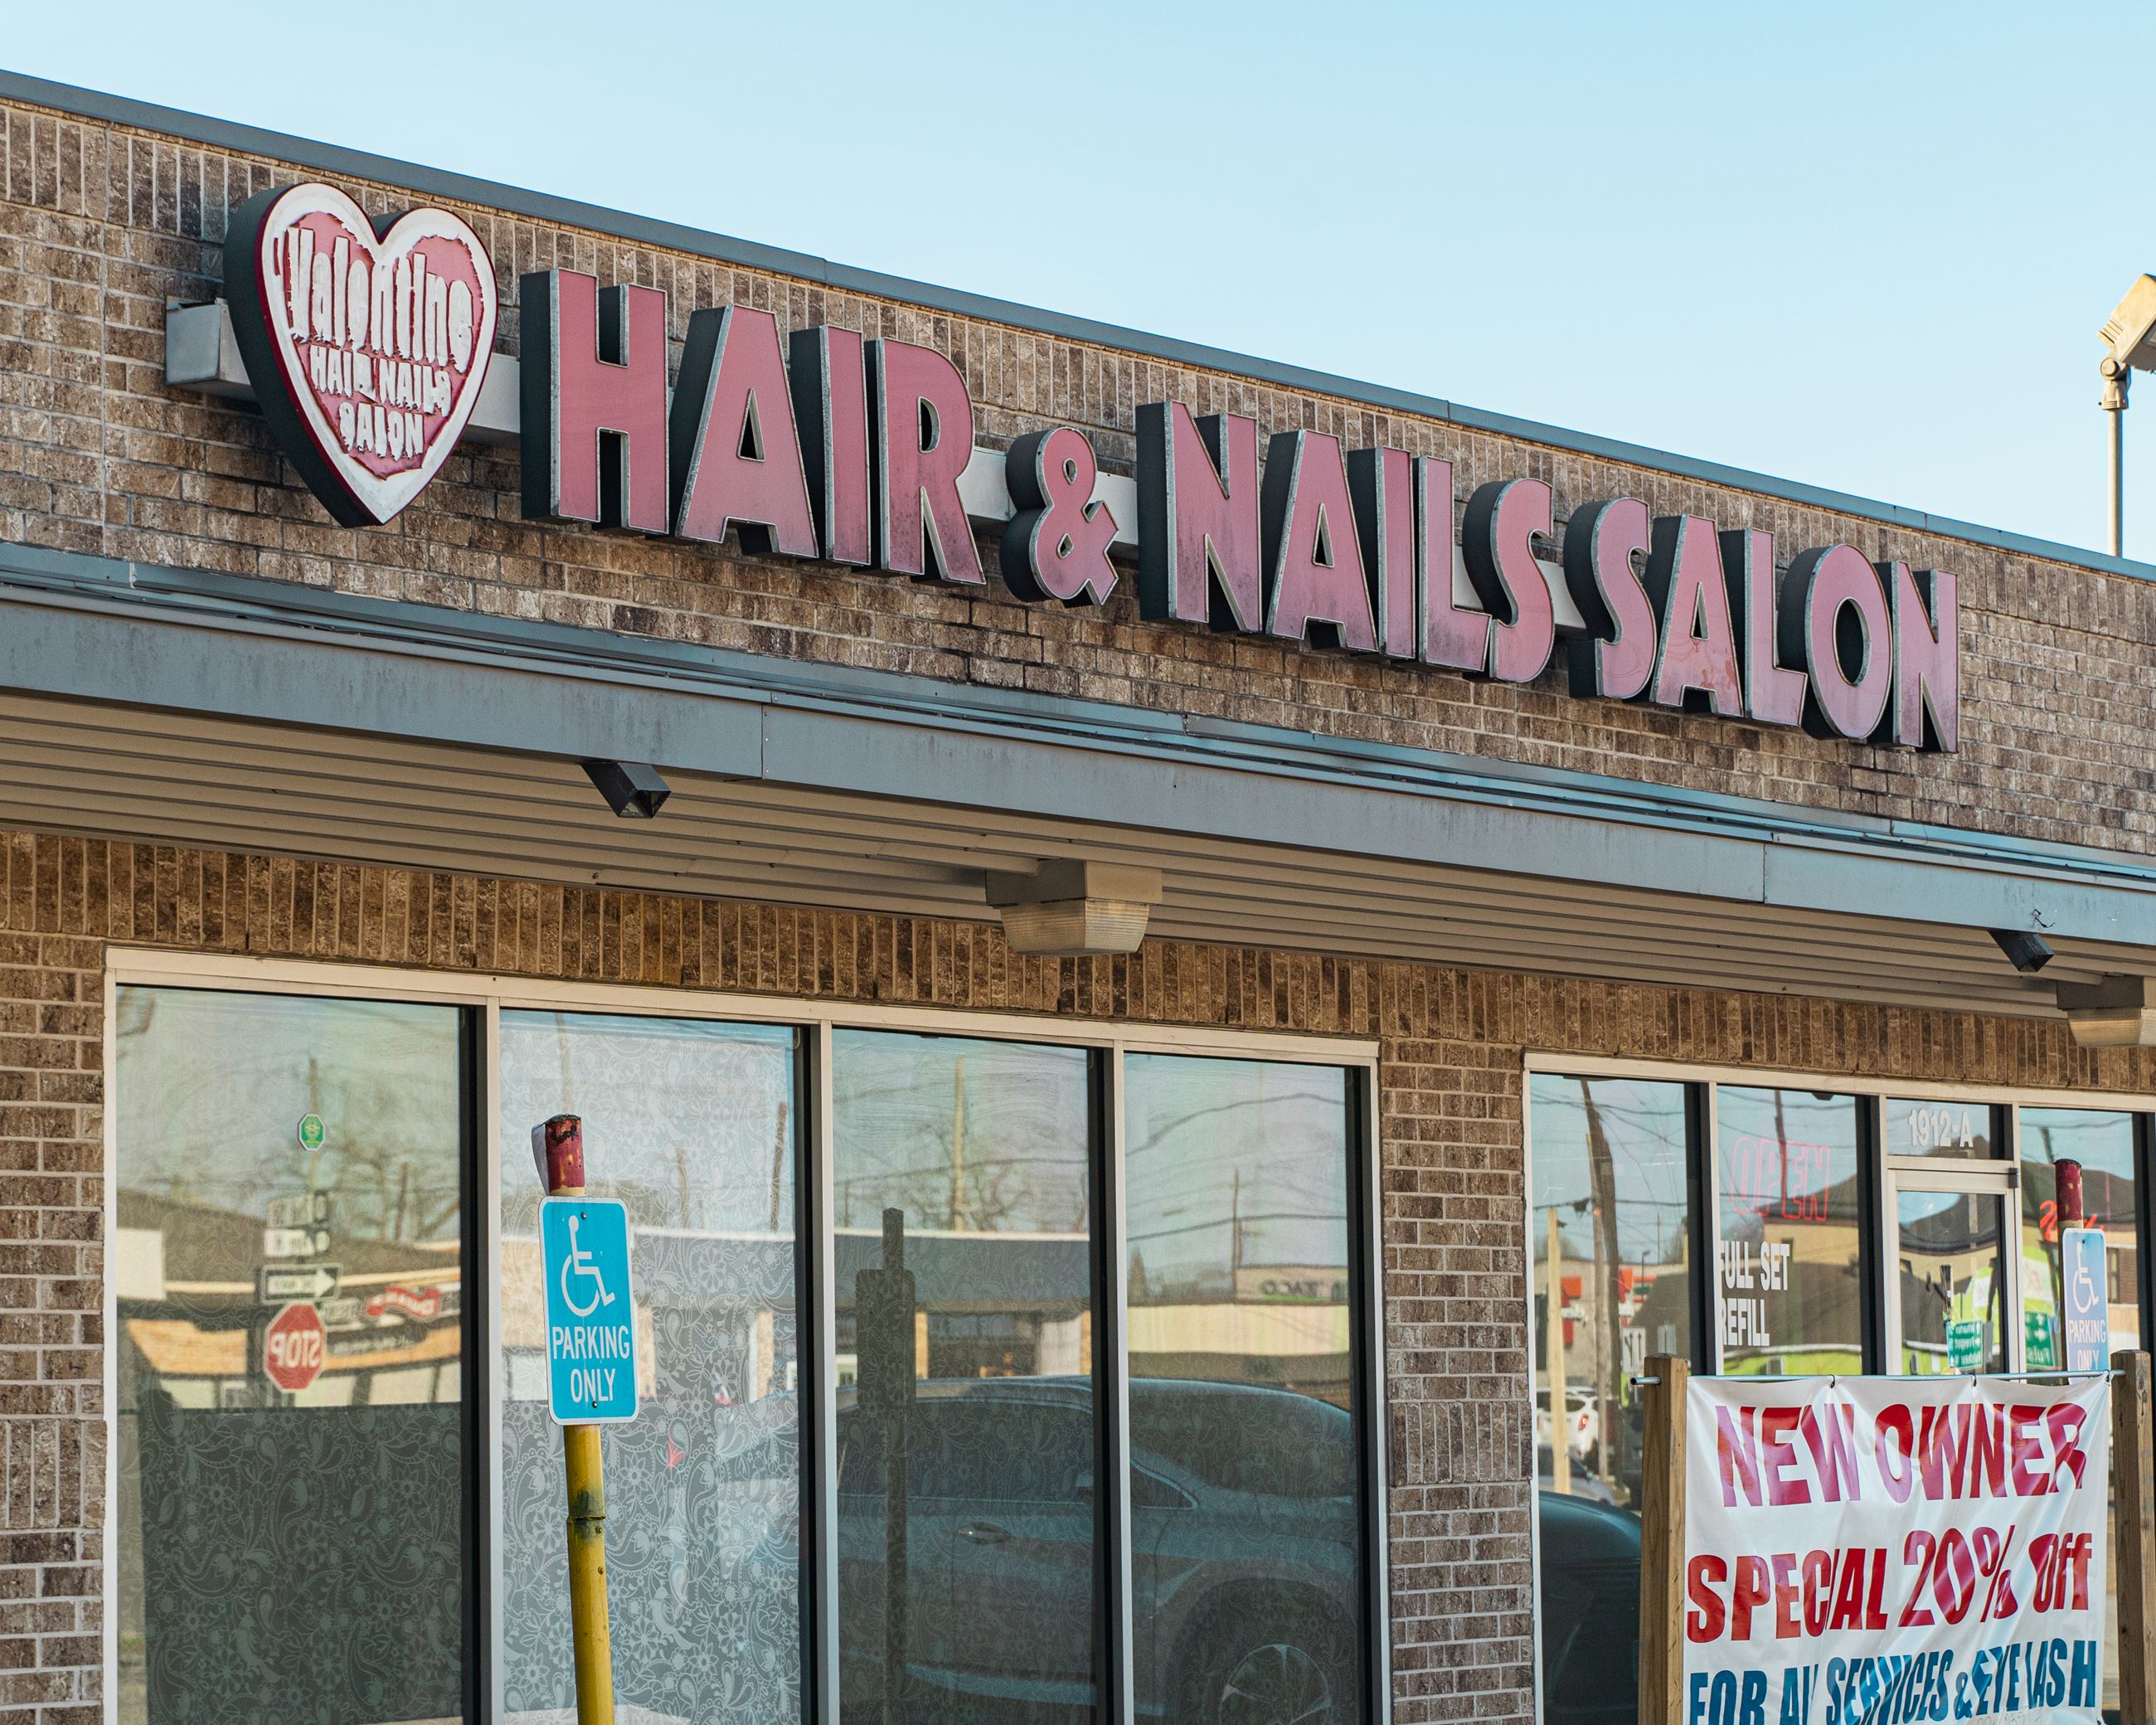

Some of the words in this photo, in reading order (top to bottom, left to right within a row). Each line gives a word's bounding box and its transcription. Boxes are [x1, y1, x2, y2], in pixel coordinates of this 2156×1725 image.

[339, 402, 424, 462] SALON
[547, 268, 986, 586] HAIR
[1024, 425, 1119, 607] &
[1161, 400, 1555, 683] NAILS
[1584, 497, 1958, 753] SALON
[1908, 1109, 1974, 1148] 1912-A
[1760, 1241, 1790, 1291] SET
[551, 1325, 630, 1360] PARKING
[2068, 1319, 2106, 1344] PARKING
[570, 1368, 617, 1403] ONLY
[2077, 1349, 2100, 1372] ONLY
[1715, 1403, 1862, 1508] NEW
[1874, 1402, 2087, 1504] OWNER
[1898, 1524, 2018, 1628] 20%
[1689, 1669, 1768, 1725] FOR
[1825, 1649, 1954, 1725] SERVICES
[1954, 1671, 1973, 1720] &
